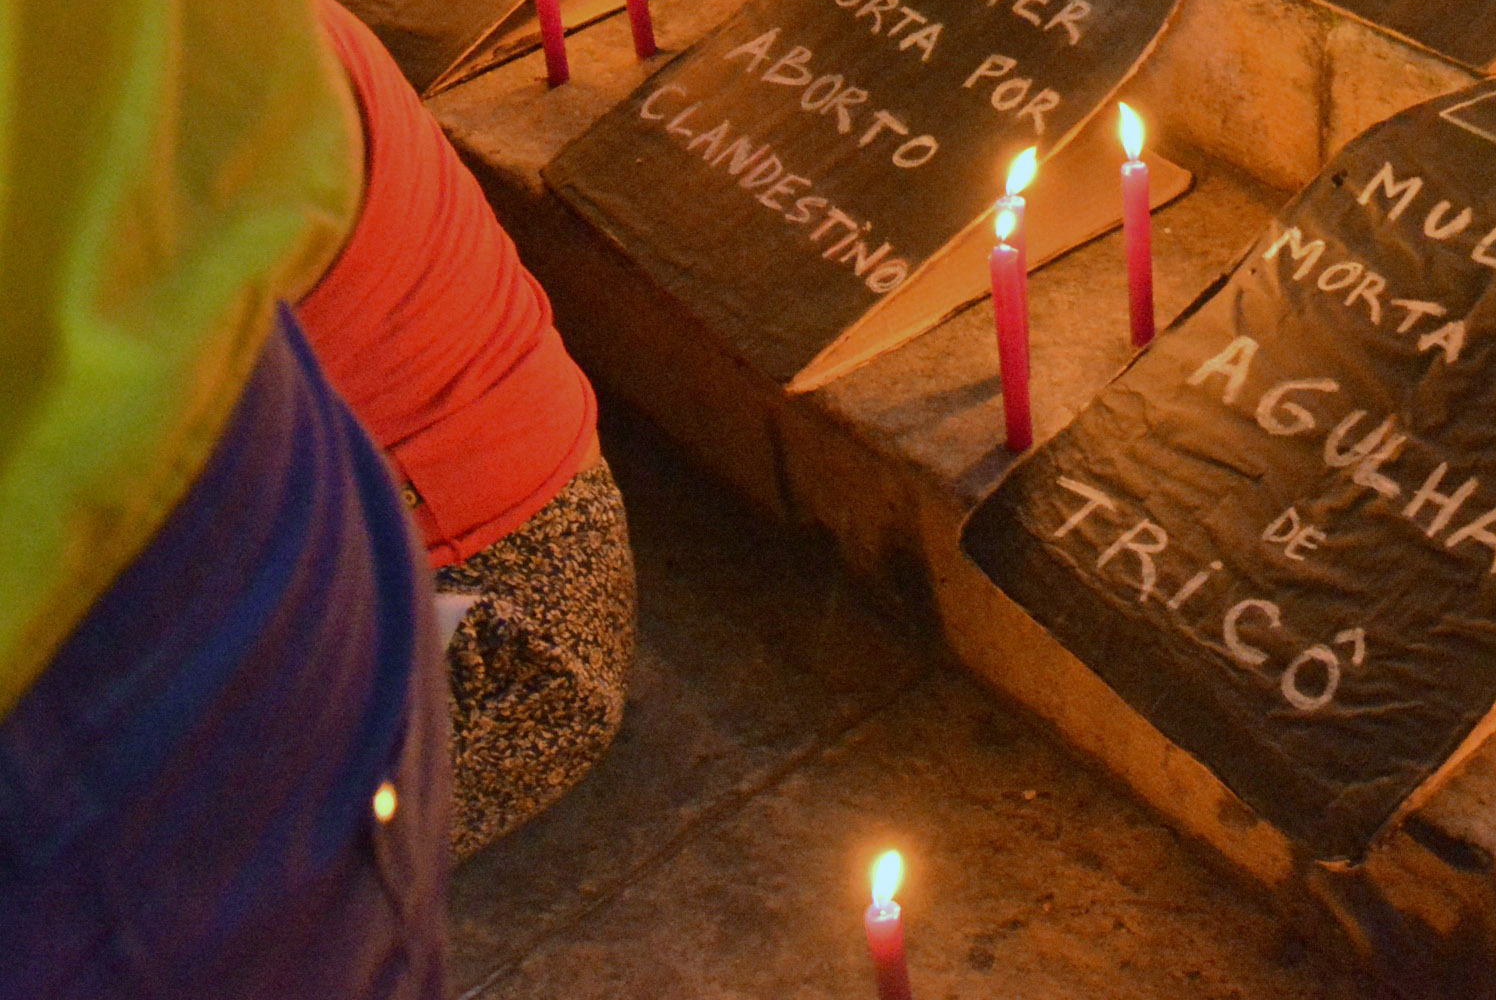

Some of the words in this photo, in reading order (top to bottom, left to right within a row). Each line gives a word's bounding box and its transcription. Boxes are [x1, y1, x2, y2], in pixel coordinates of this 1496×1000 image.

[724, 27, 939, 169] ABORTO
[963, 53, 1061, 136] POR
[1263, 224, 1469, 365] MORTA
[1262, 506, 1328, 561] DE
